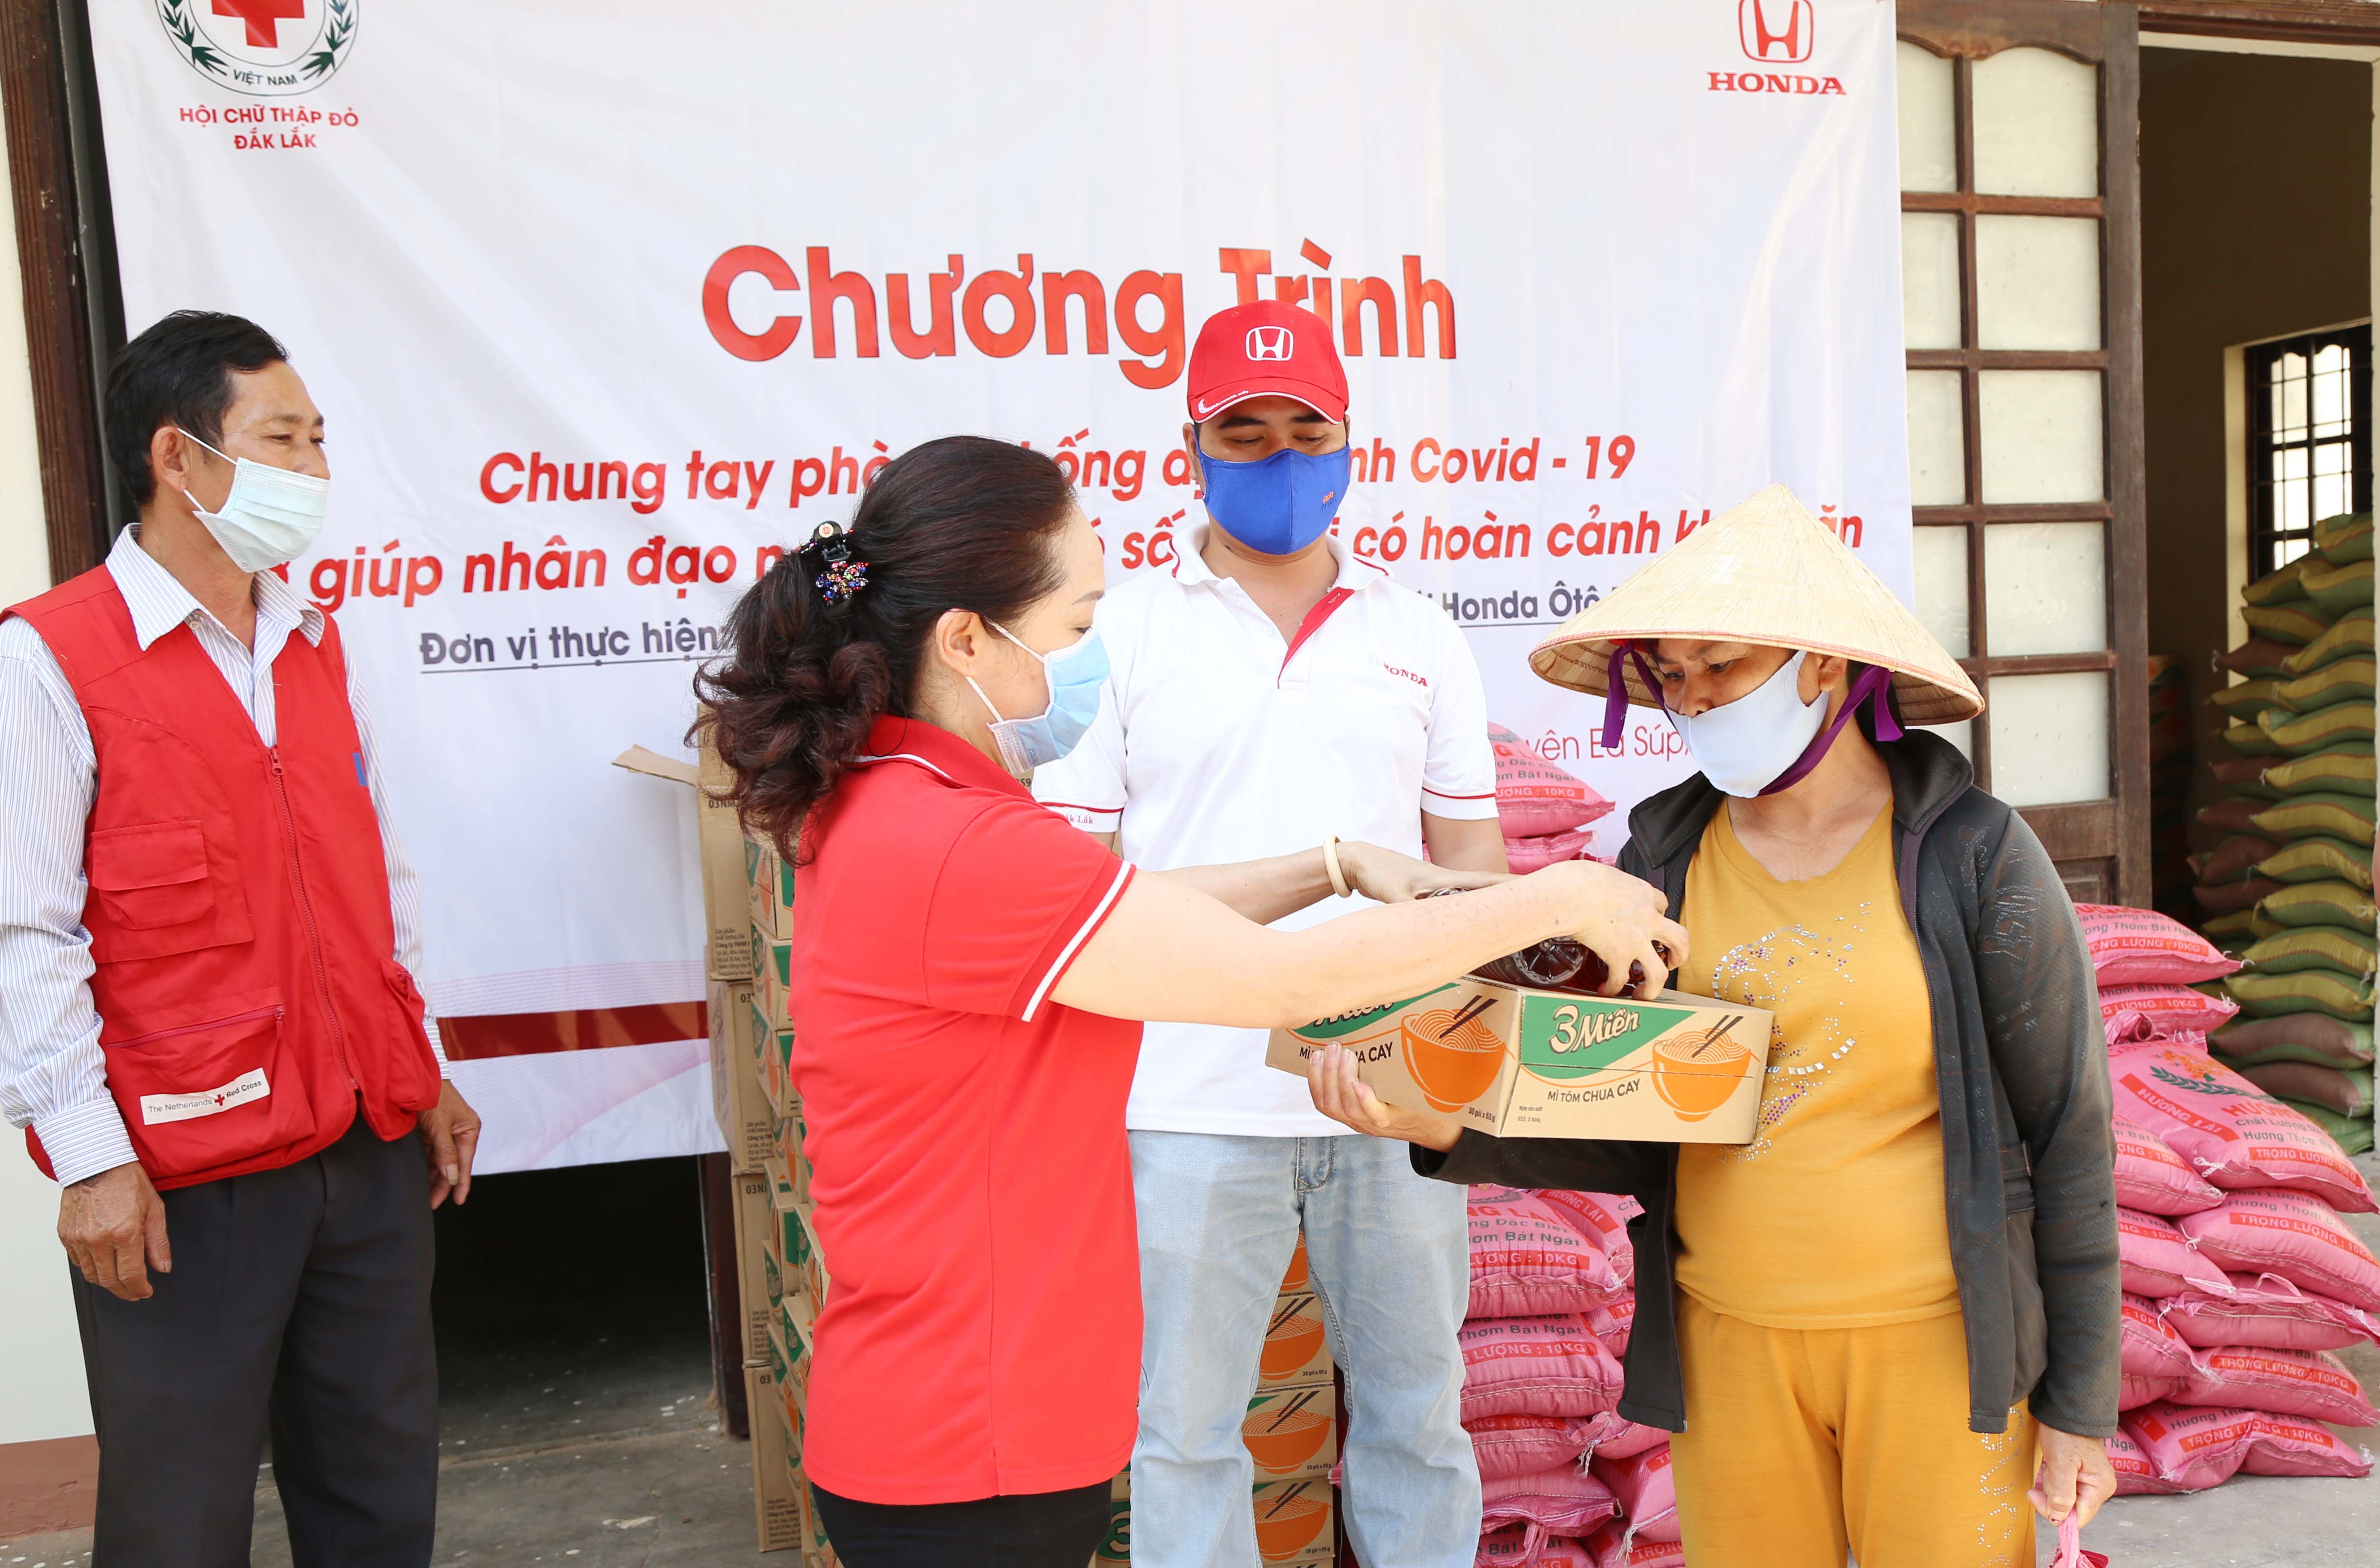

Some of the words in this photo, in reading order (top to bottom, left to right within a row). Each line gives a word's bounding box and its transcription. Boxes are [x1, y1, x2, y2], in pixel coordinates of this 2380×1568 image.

[233, 69, 263, 86] VIỆT
[268, 74, 298, 86] NAM
[1707, 72, 1847, 96] HONDA
[179, 104, 217, 128] HỘI
[224, 103, 265, 123] CHỮ
[270, 105, 322, 127] THẬP
[328, 107, 359, 127] ĐỎ
[234, 127, 276, 149] ĐẮK
[280, 125, 317, 149] LẮK
[702, 243, 1186, 390] Chương
[479, 451, 666, 514] Chung
[686, 450, 774, 510] tay
[1410, 436, 1540, 483] Covid
[1584, 434, 1636, 480] 19
[310, 539, 443, 614] giúp
[462, 535, 606, 593] nhân
[627, 535, 737, 599] đạo
[1353, 510, 1407, 562] có
[1420, 510, 1531, 561] hoàn
[1547, 504, 1661, 557] cảnh
[419, 632, 496, 665] Đơn
[507, 628, 537, 669] vị
[549, 626, 630, 666] thực
[1442, 590, 1539, 621] Honda
[1383, 660, 1429, 687] HONDA
[1496, 787, 1533, 798] ƯỢNG
[1544, 787, 1576, 797] 10KG
[2122, 938, 2163, 950] LƯỢNG
[2173, 941, 2201, 952] 10KG
[2167, 999, 2197, 1008] 10KG
[1368, 1041, 1394, 1062] CAY
[148, 1105, 163, 1114] The
[165, 1098, 213, 1112] Netherlands
[226, 1087, 240, 1099] Red
[241, 1080, 262, 1092] Cross
[1547, 1090, 1559, 1101] MÌ
[1561, 1089, 1581, 1103] TÔM
[1583, 1088, 1615, 1103] CHUA
[1617, 1078, 1641, 1097] CAY
[2137, 1088, 2192, 1121] HƯƠNG
[2155, 1152, 2185, 1169] 10KG
[2256, 1148, 2297, 1160] TRỌNG
[2239, 1214, 2290, 1228] TRỌNG
[2293, 1220, 2338, 1244] LƯỢNG
[1537, 1253, 1577, 1265] 10KG
[1473, 1344, 1532, 1359] LƯỢNG
[1546, 1342, 1586, 1354] 10KG
[2317, 1372, 2350, 1389] 10KG
[1512, 1417, 1554, 1429] 10KG
[2187, 1428, 2235, 1448] TRỌNG
[2293, 1428, 2324, 1444] 10KG
